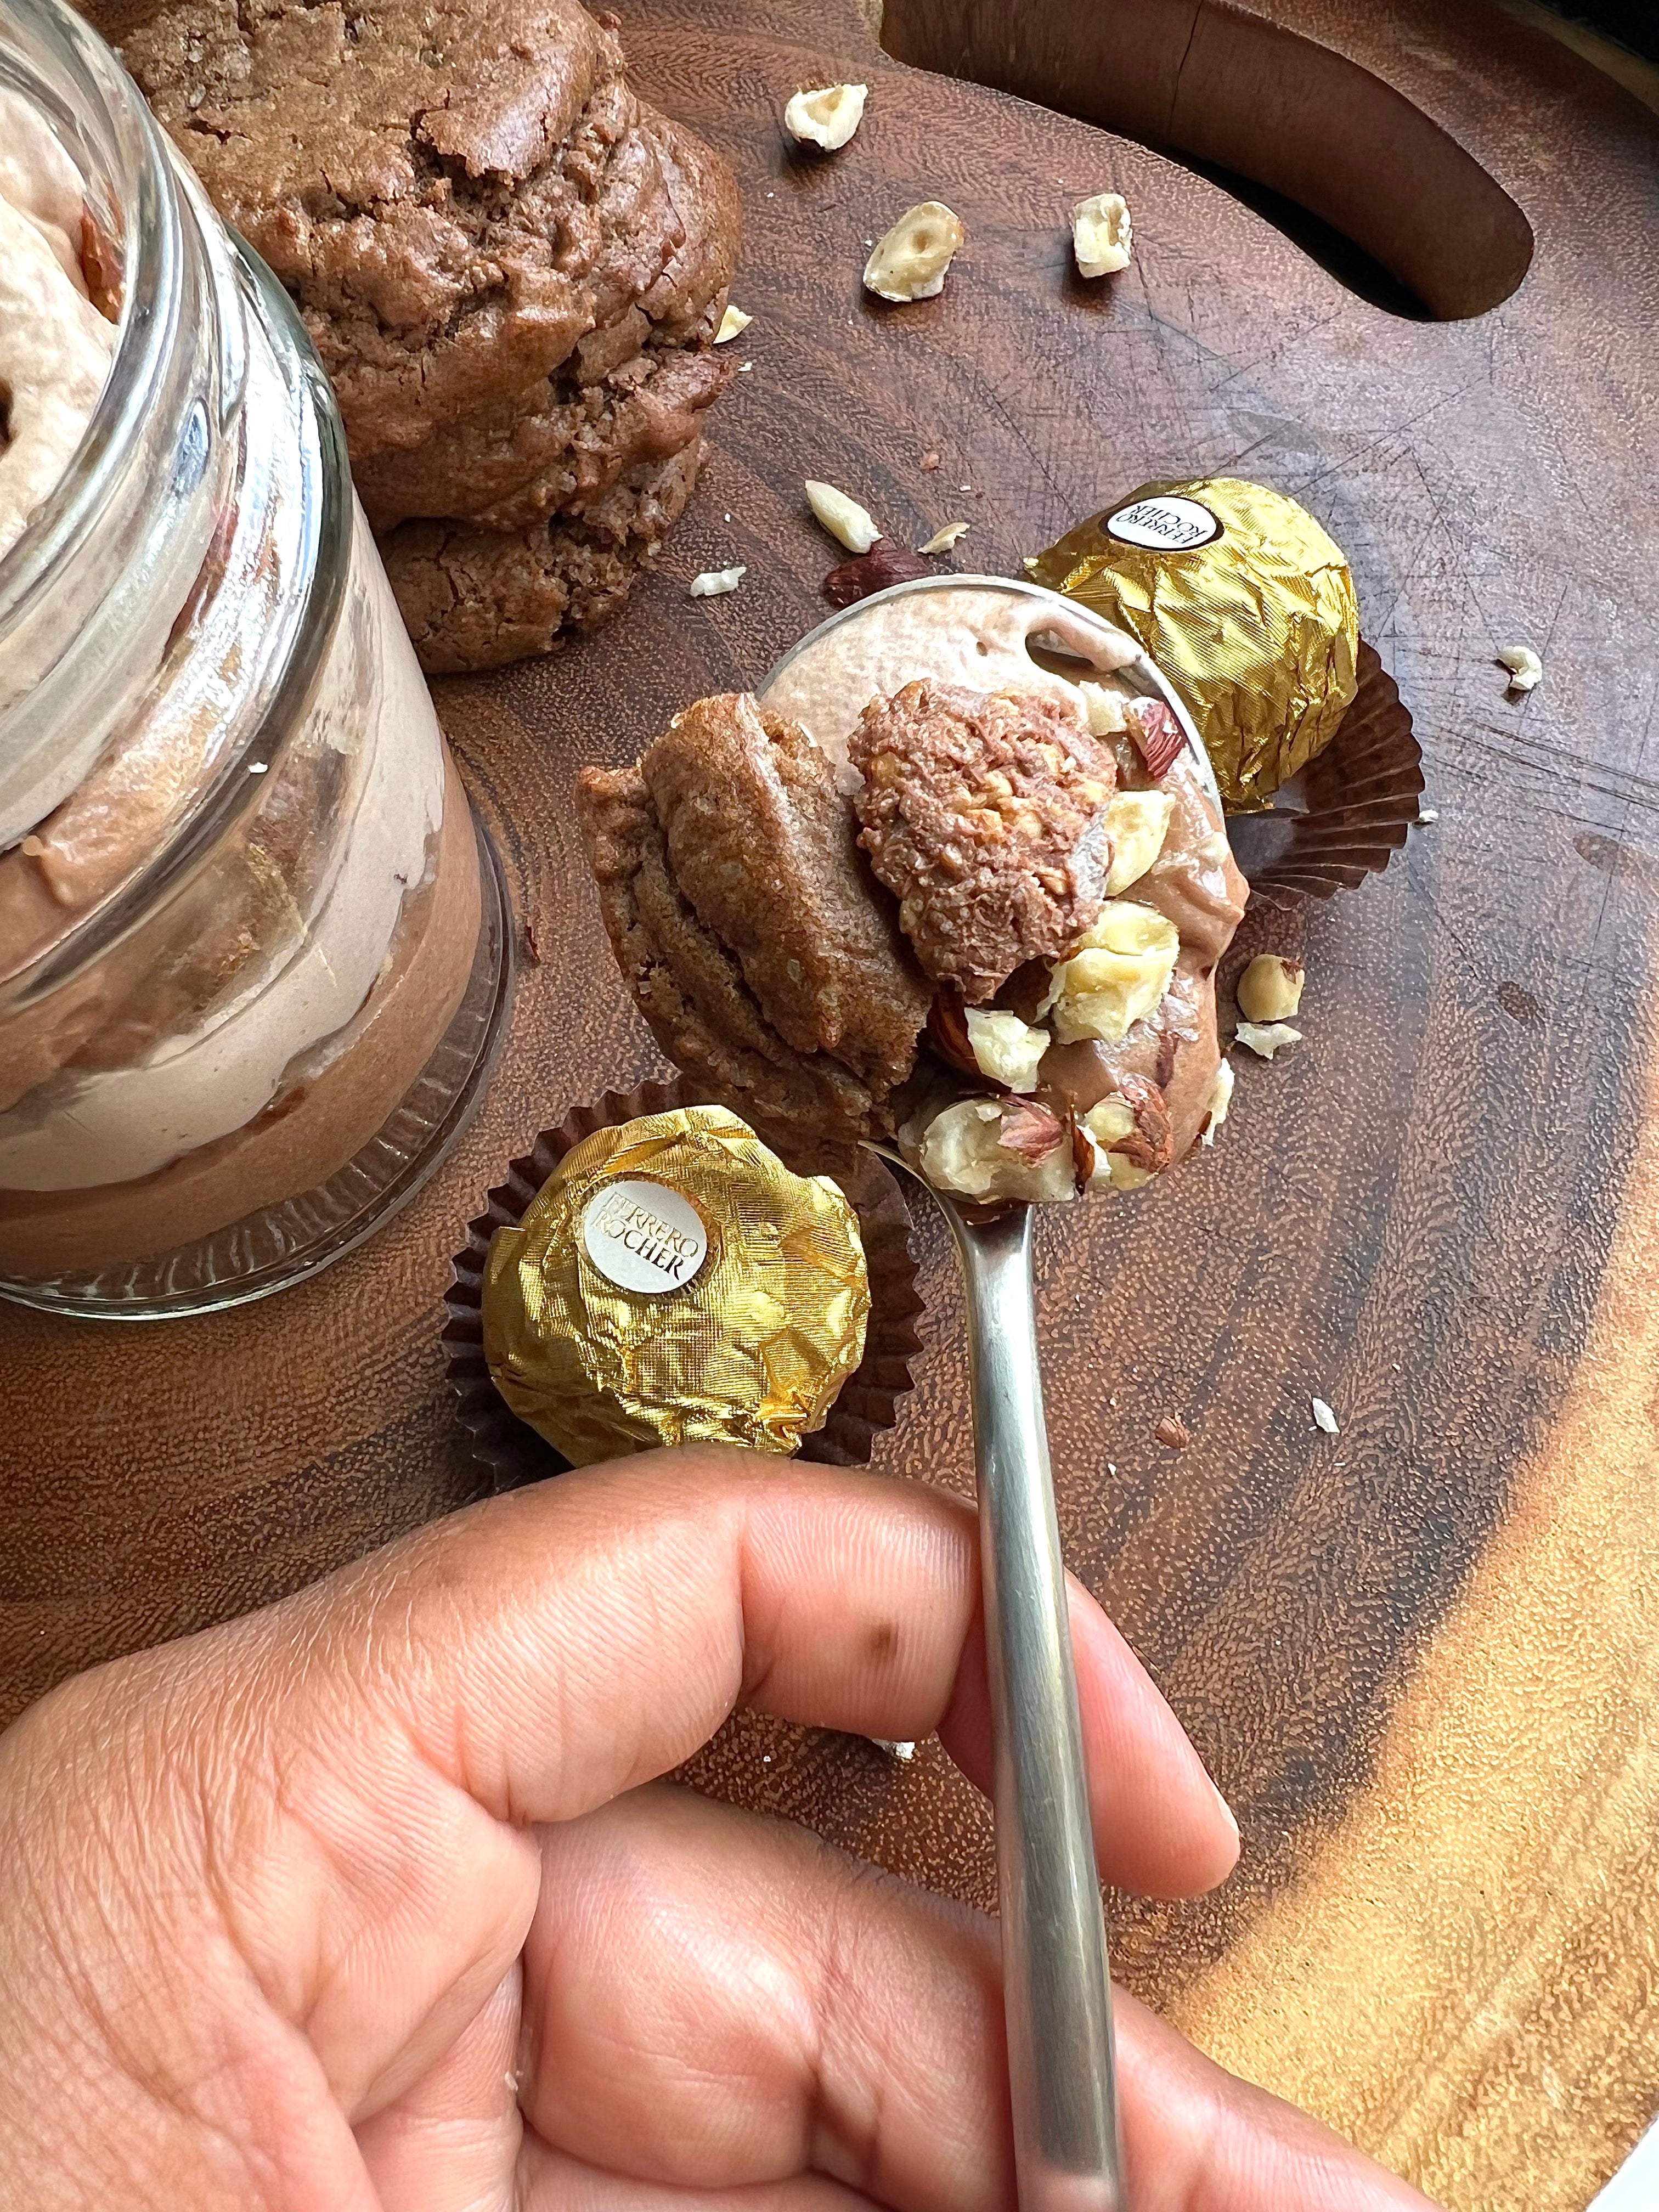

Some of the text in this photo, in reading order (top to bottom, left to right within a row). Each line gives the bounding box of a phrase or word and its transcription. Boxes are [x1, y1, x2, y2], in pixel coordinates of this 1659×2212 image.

[1116, 514, 1194, 544] FERRERO
[1131, 505, 1208, 538] ROCHER
[591, 1210, 684, 1281] ROCHER
[603, 1192, 699, 1257] FERRERO
